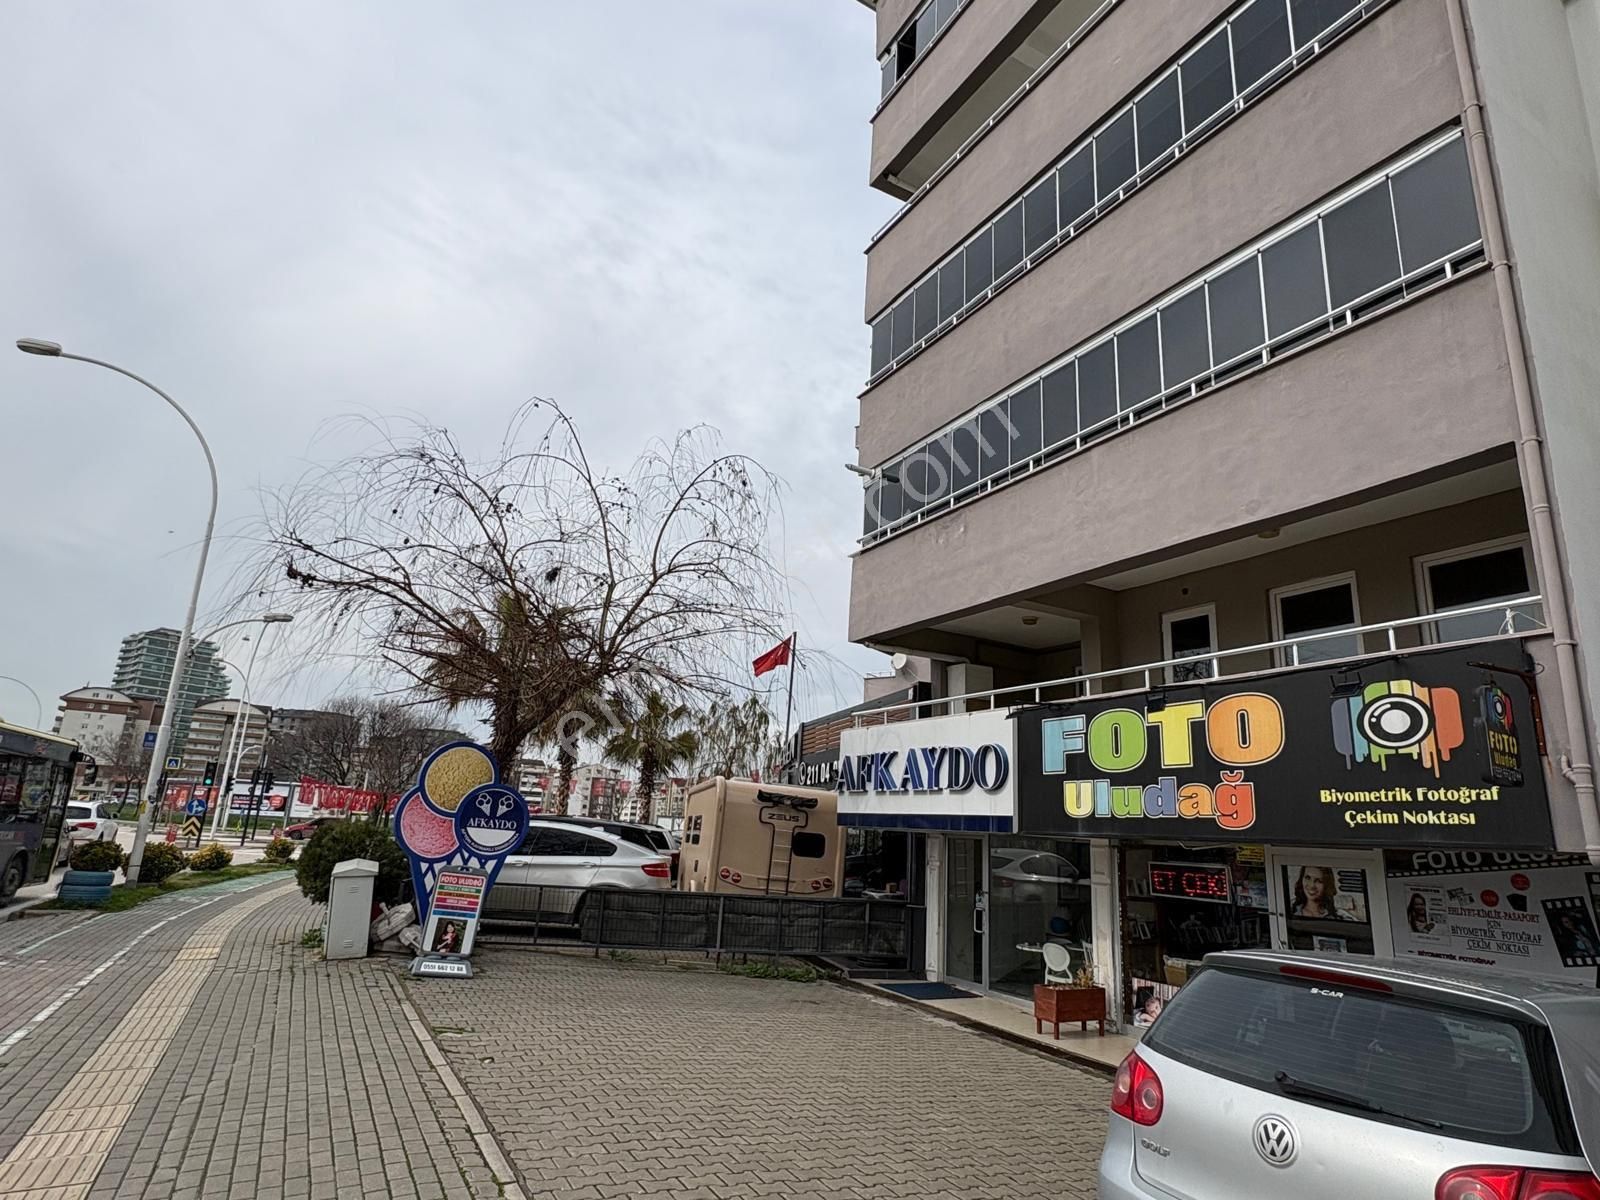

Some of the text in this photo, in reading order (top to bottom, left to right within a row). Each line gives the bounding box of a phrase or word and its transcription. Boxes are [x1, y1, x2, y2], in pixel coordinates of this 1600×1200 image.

[1041, 692, 1286, 775] FOTO
[1488, 730, 1517, 755] FOTO
[835, 743, 1010, 794] AFKAYDO
[1063, 769, 1256, 831] Uludağ
[1320, 785, 1501, 805] Biyometrik Fotoğraf
[467, 817, 517, 830] AFKAYDO
[767, 813, 800, 822] ZEUS
[1344, 810, 1477, 828] Çekim Noktası
[1412, 850, 1482, 870] FOTO
[440, 875, 457, 884] FOTO
[1451, 924, 1497, 939] BİYOMETRİK
[1501, 930, 1543, 944] FOTOĞRAF
[1467, 938, 1530, 955] ÇEKİM NOKTASI
